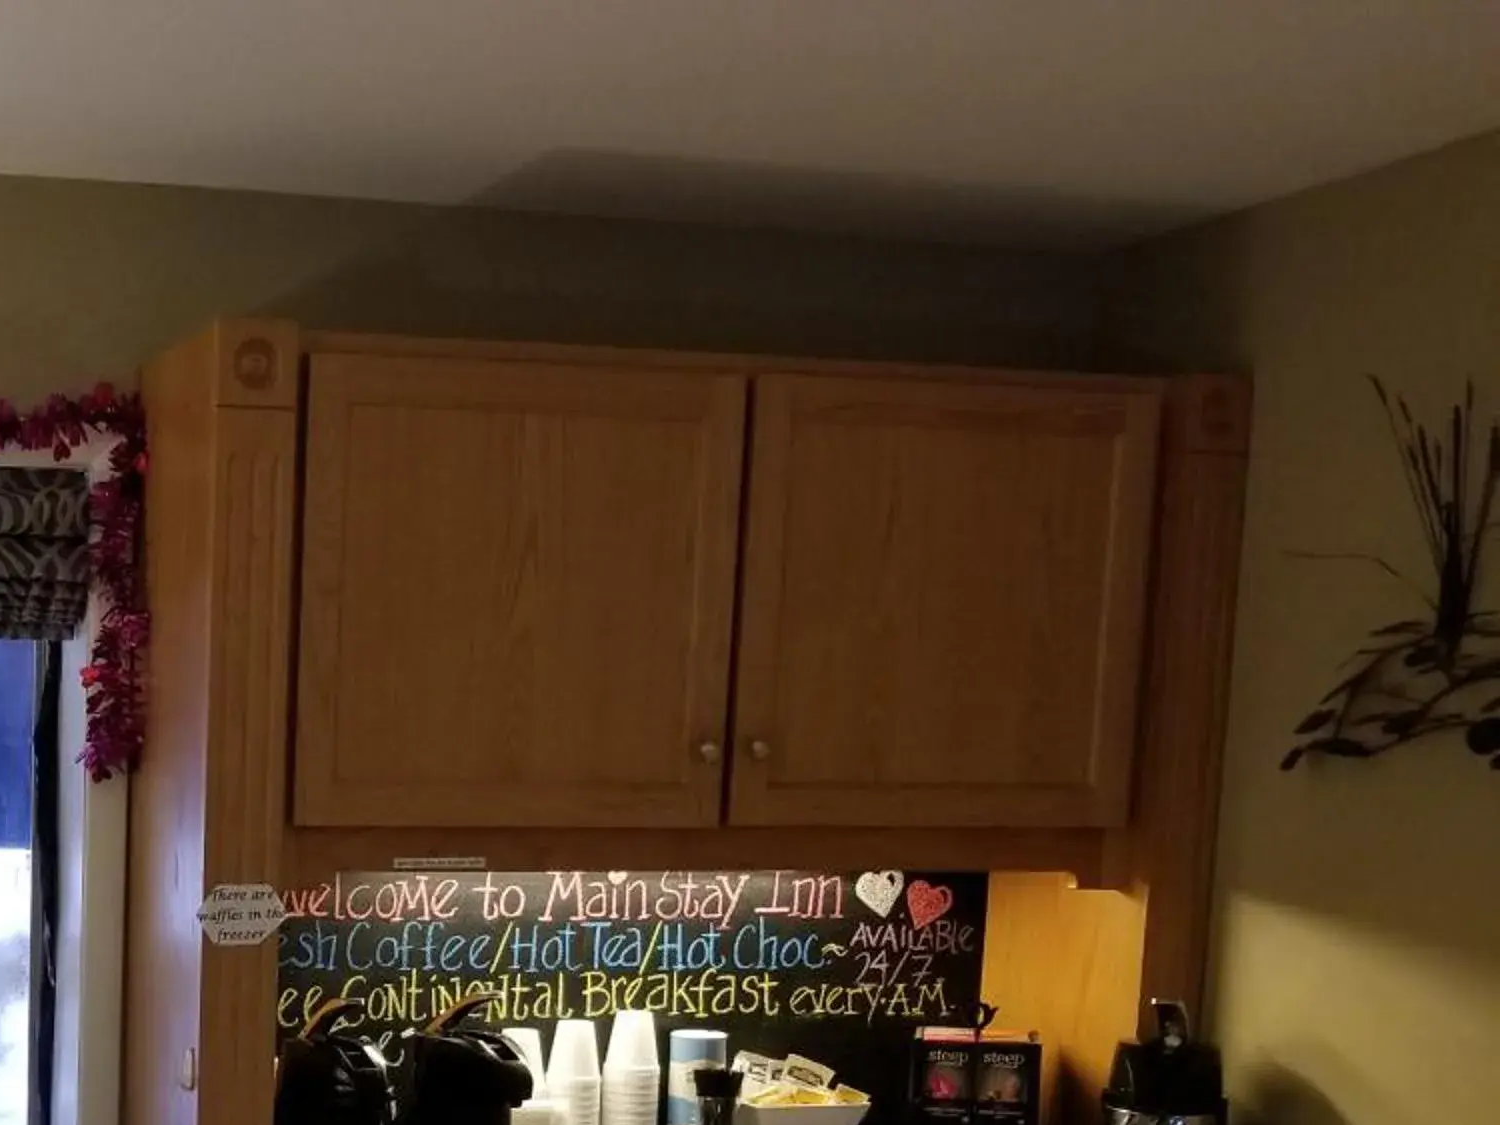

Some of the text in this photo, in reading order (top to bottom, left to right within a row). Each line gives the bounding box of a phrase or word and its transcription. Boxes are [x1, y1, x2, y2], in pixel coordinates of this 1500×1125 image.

[212, 889, 275, 903] There are
[472, 871, 526, 921] to
[753, 870, 844, 920] Inn
[196, 908, 284, 924] waffles in the
[217, 928, 264, 943] freezer
[853, 950, 935, 988] 24/7
[580, 967, 781, 1019] Breakfast
[928, 1048, 1025, 1069] steep steep
